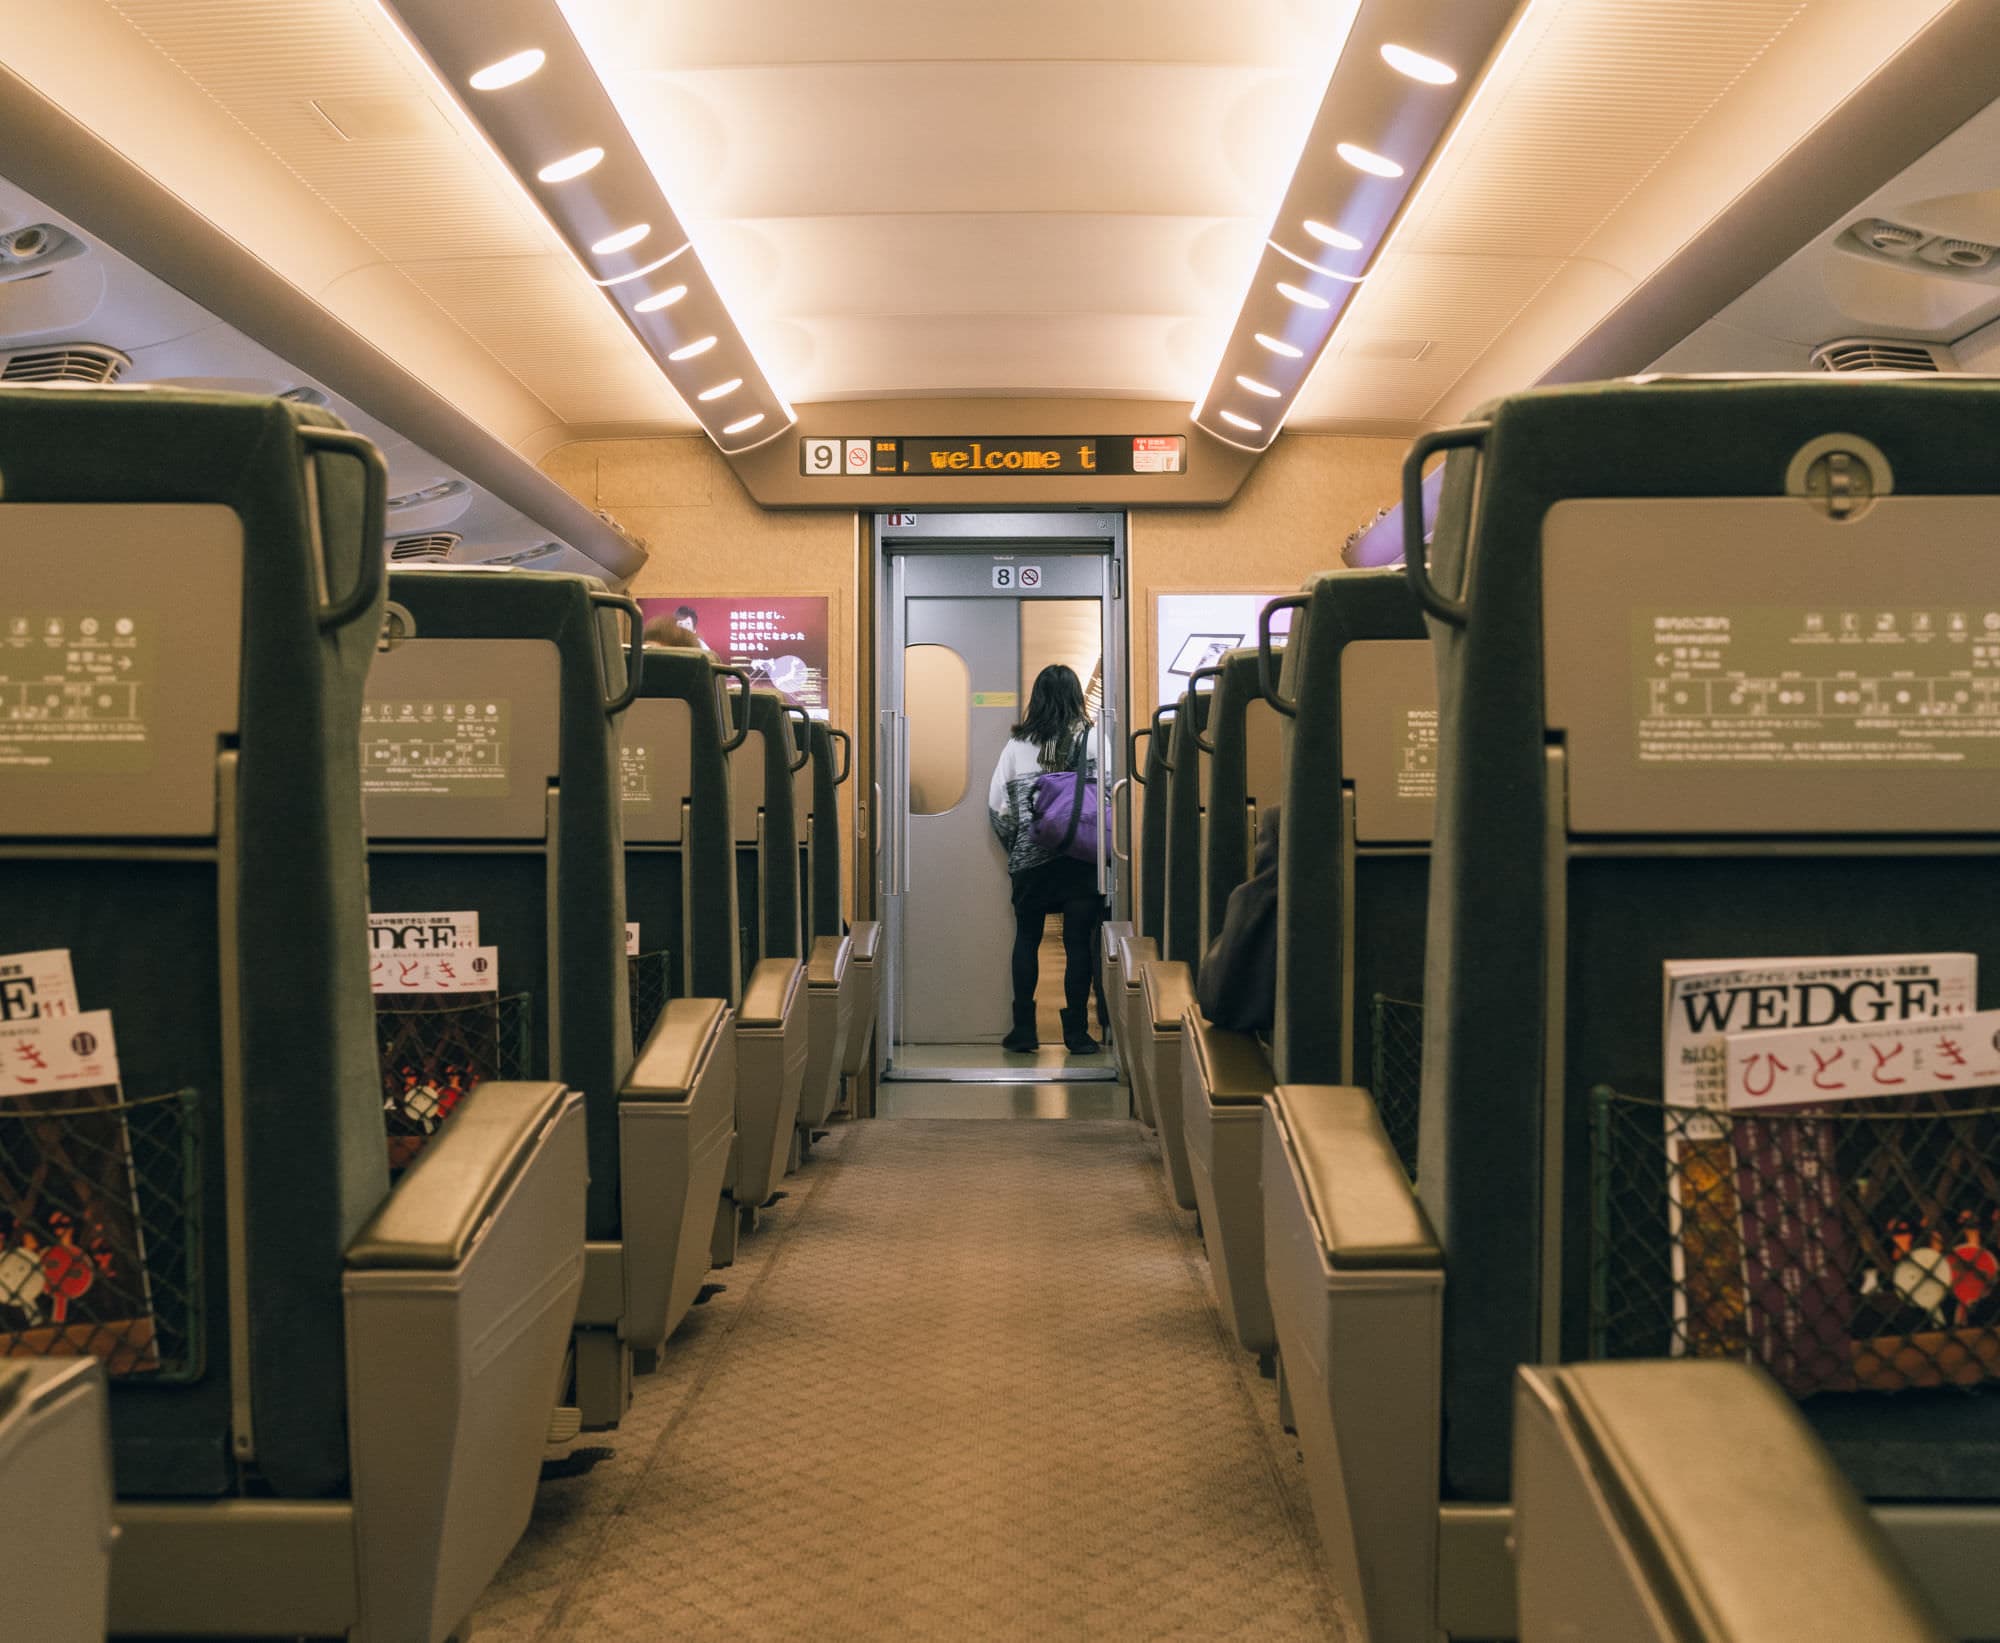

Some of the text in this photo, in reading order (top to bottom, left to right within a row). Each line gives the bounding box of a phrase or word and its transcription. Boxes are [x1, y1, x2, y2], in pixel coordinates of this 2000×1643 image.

[814, 445, 833, 470] 9
[929, 443, 1061, 470] welcome
[1077, 445, 1096, 470] t
[997, 568, 1010, 586] 8
[1681, 979, 1939, 1034] WEDGE
[1740, 1036, 1968, 1097] ひととき
